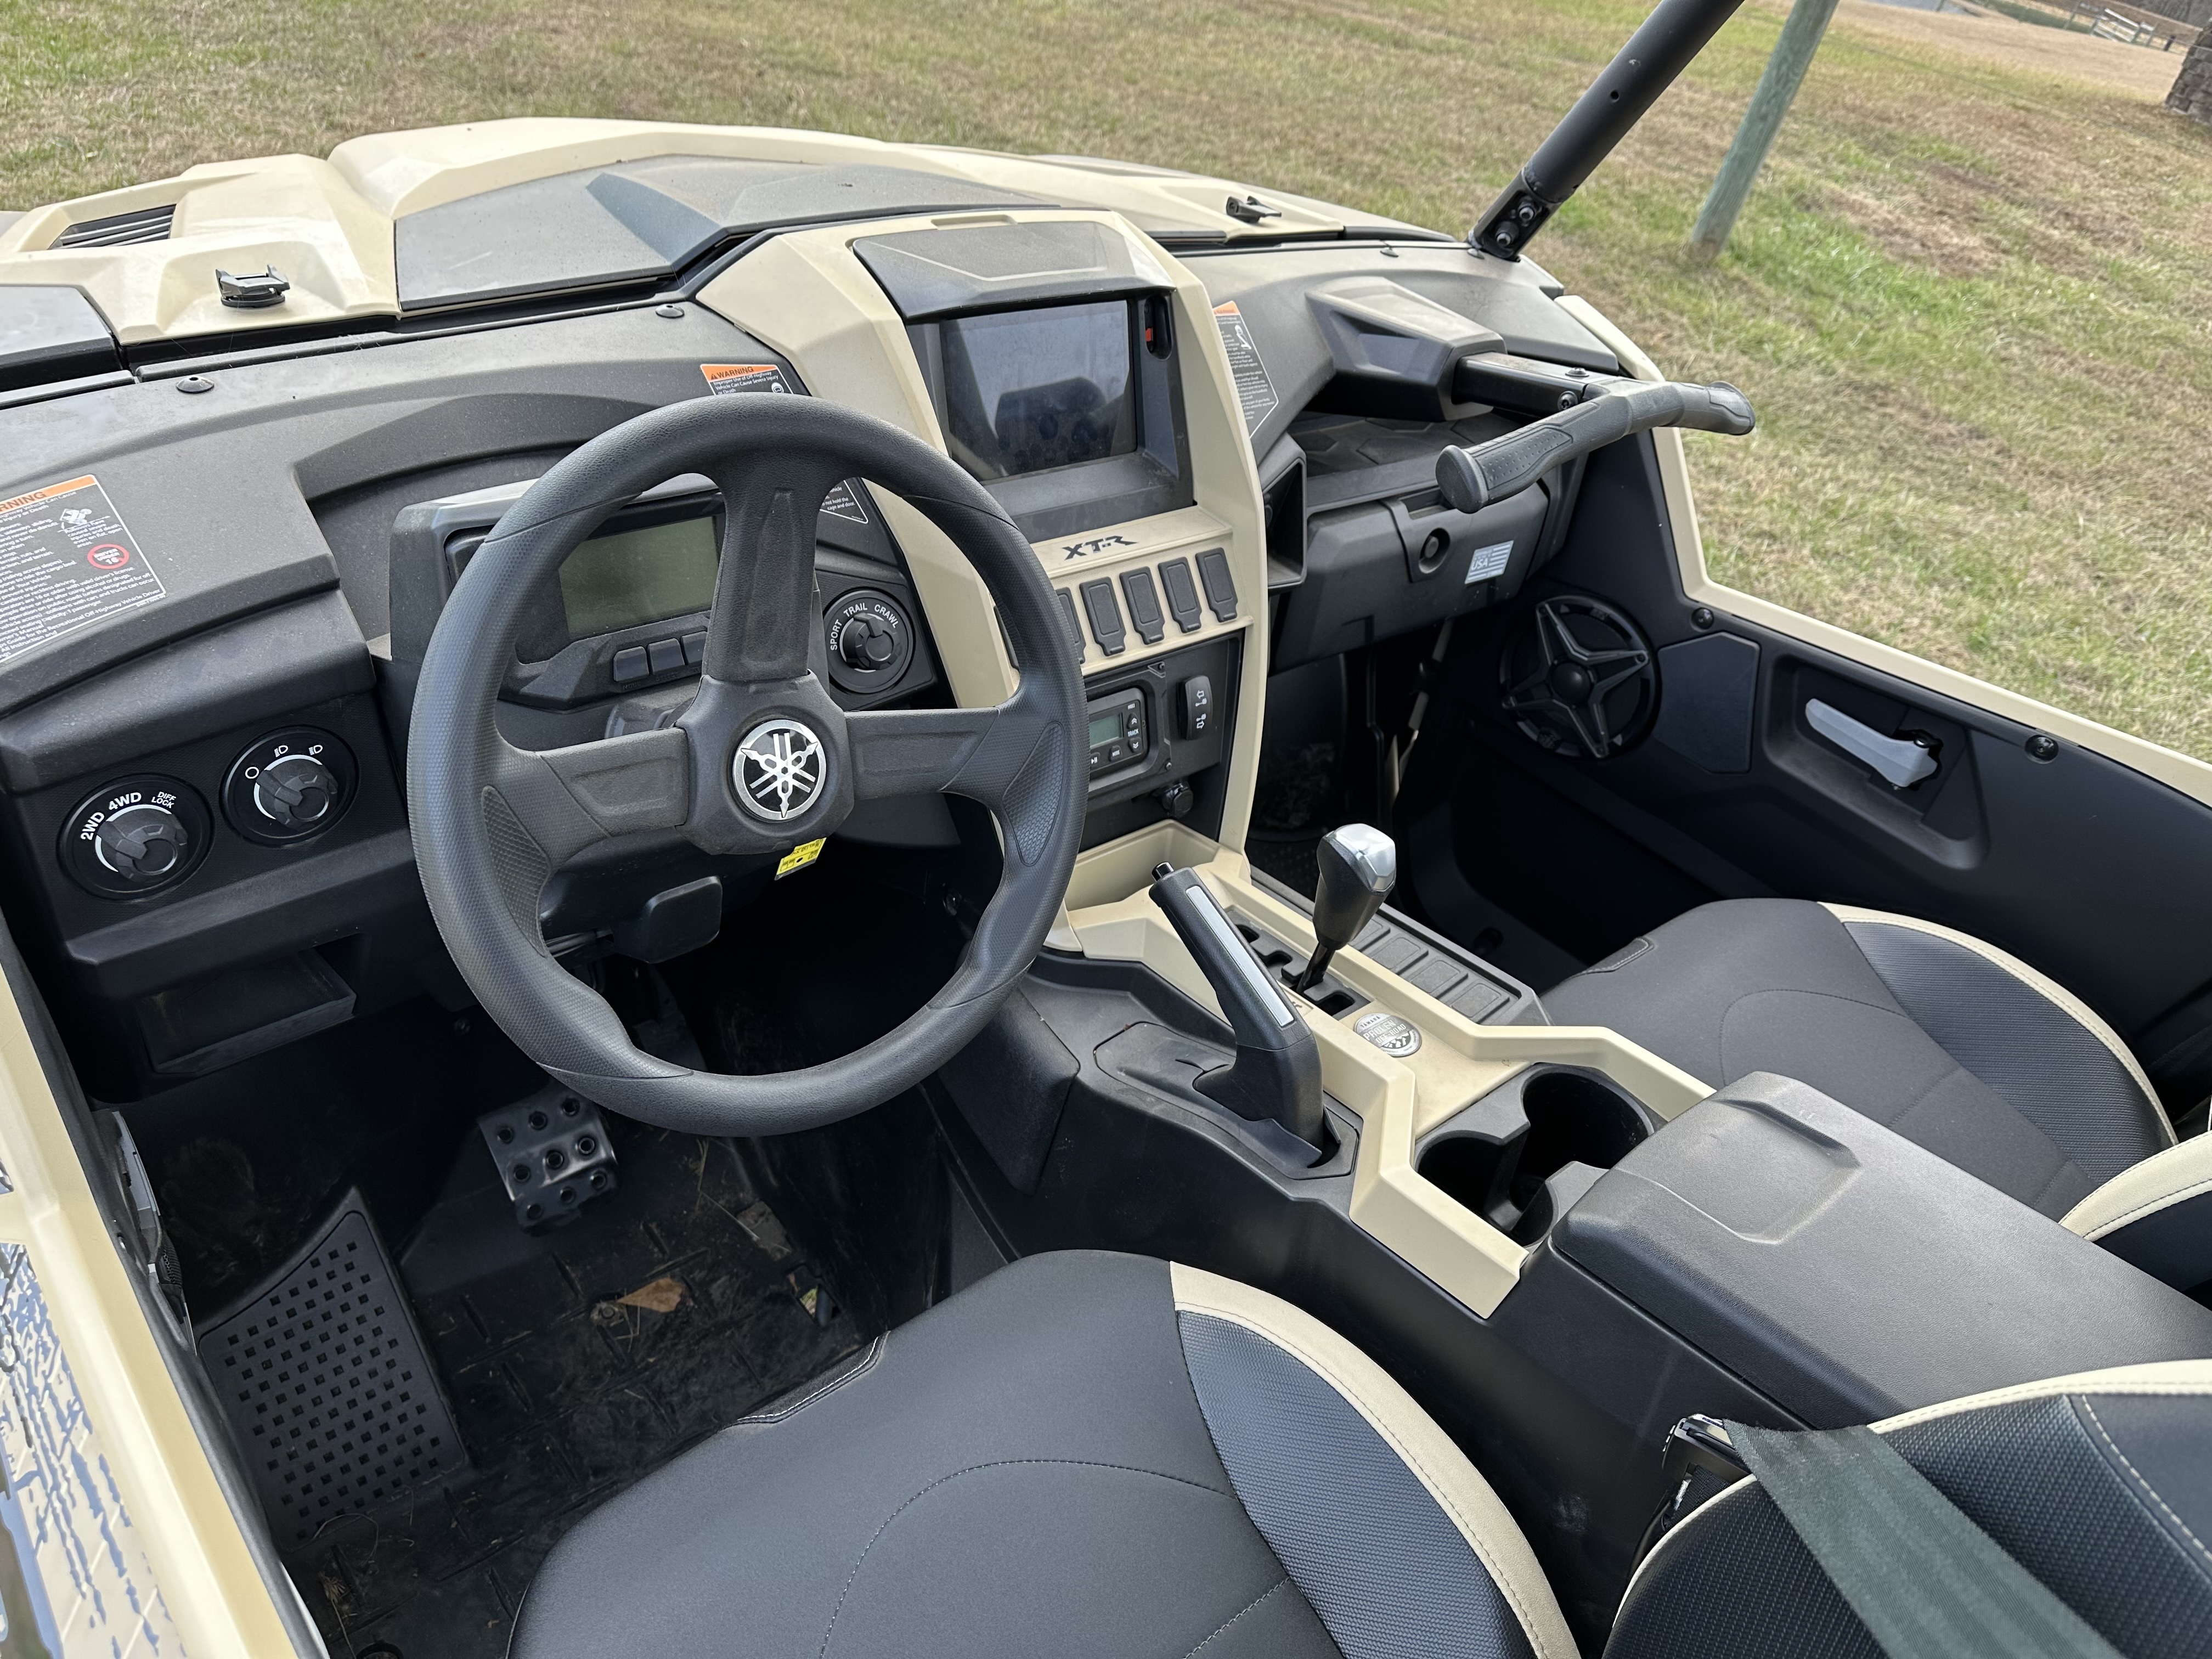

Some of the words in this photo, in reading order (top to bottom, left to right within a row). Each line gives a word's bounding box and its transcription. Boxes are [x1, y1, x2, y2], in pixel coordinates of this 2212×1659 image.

[717, 366, 754, 379] WARNING
[67, 528, 88, 537] caused
[93, 548, 118, 558] DRIVER
[97, 552, 120, 561] UNDER
[1471, 558, 1488, 571] USA
[29, 575, 52, 583] Vehicle
[94, 573, 115, 581] driver's
[85, 580, 106, 590] alcohol
[0, 596, 24, 605] careless
[31, 586, 54, 595] reckless
[54, 579, 76, 588] driving.
[1, 589, 25, 600] prevent
[9, 609, 38, 620] operation
[47, 600, 66, 609] public
[82, 588, 103, 597] (unless
[103, 577, 134, 591] designated
[0, 620, 21, 629] vehicle
[21, 613, 42, 623] access)
[46, 603, 73, 614] collisions
[19, 620, 42, 630] seating
[71, 600, 103, 613] passenger.
[47, 614, 85, 630] Recreational
[84, 602, 121, 617] Off-Highway
[121, 596, 143, 604] Vehicle
[19, 622, 44, 635] Manual
[830, 619, 842, 651] SPORT
[843, 602, 867, 617] TRAIL
[874, 604, 899, 628] CRAWL
[10, 636, 44, 649] Instruction
[1127, 728, 1139, 737] TRACK
[157, 791, 177, 801] DIFF
[151, 797, 175, 809] LOCK
[81, 812, 105, 840] 2WD
[108, 792, 142, 811] 4WD
[1360, 1015, 1381, 1028] YAMAHA
[1363, 1019, 1396, 1041] PROVEN
[1375, 1023, 1407, 1043] OFF-ROAD
